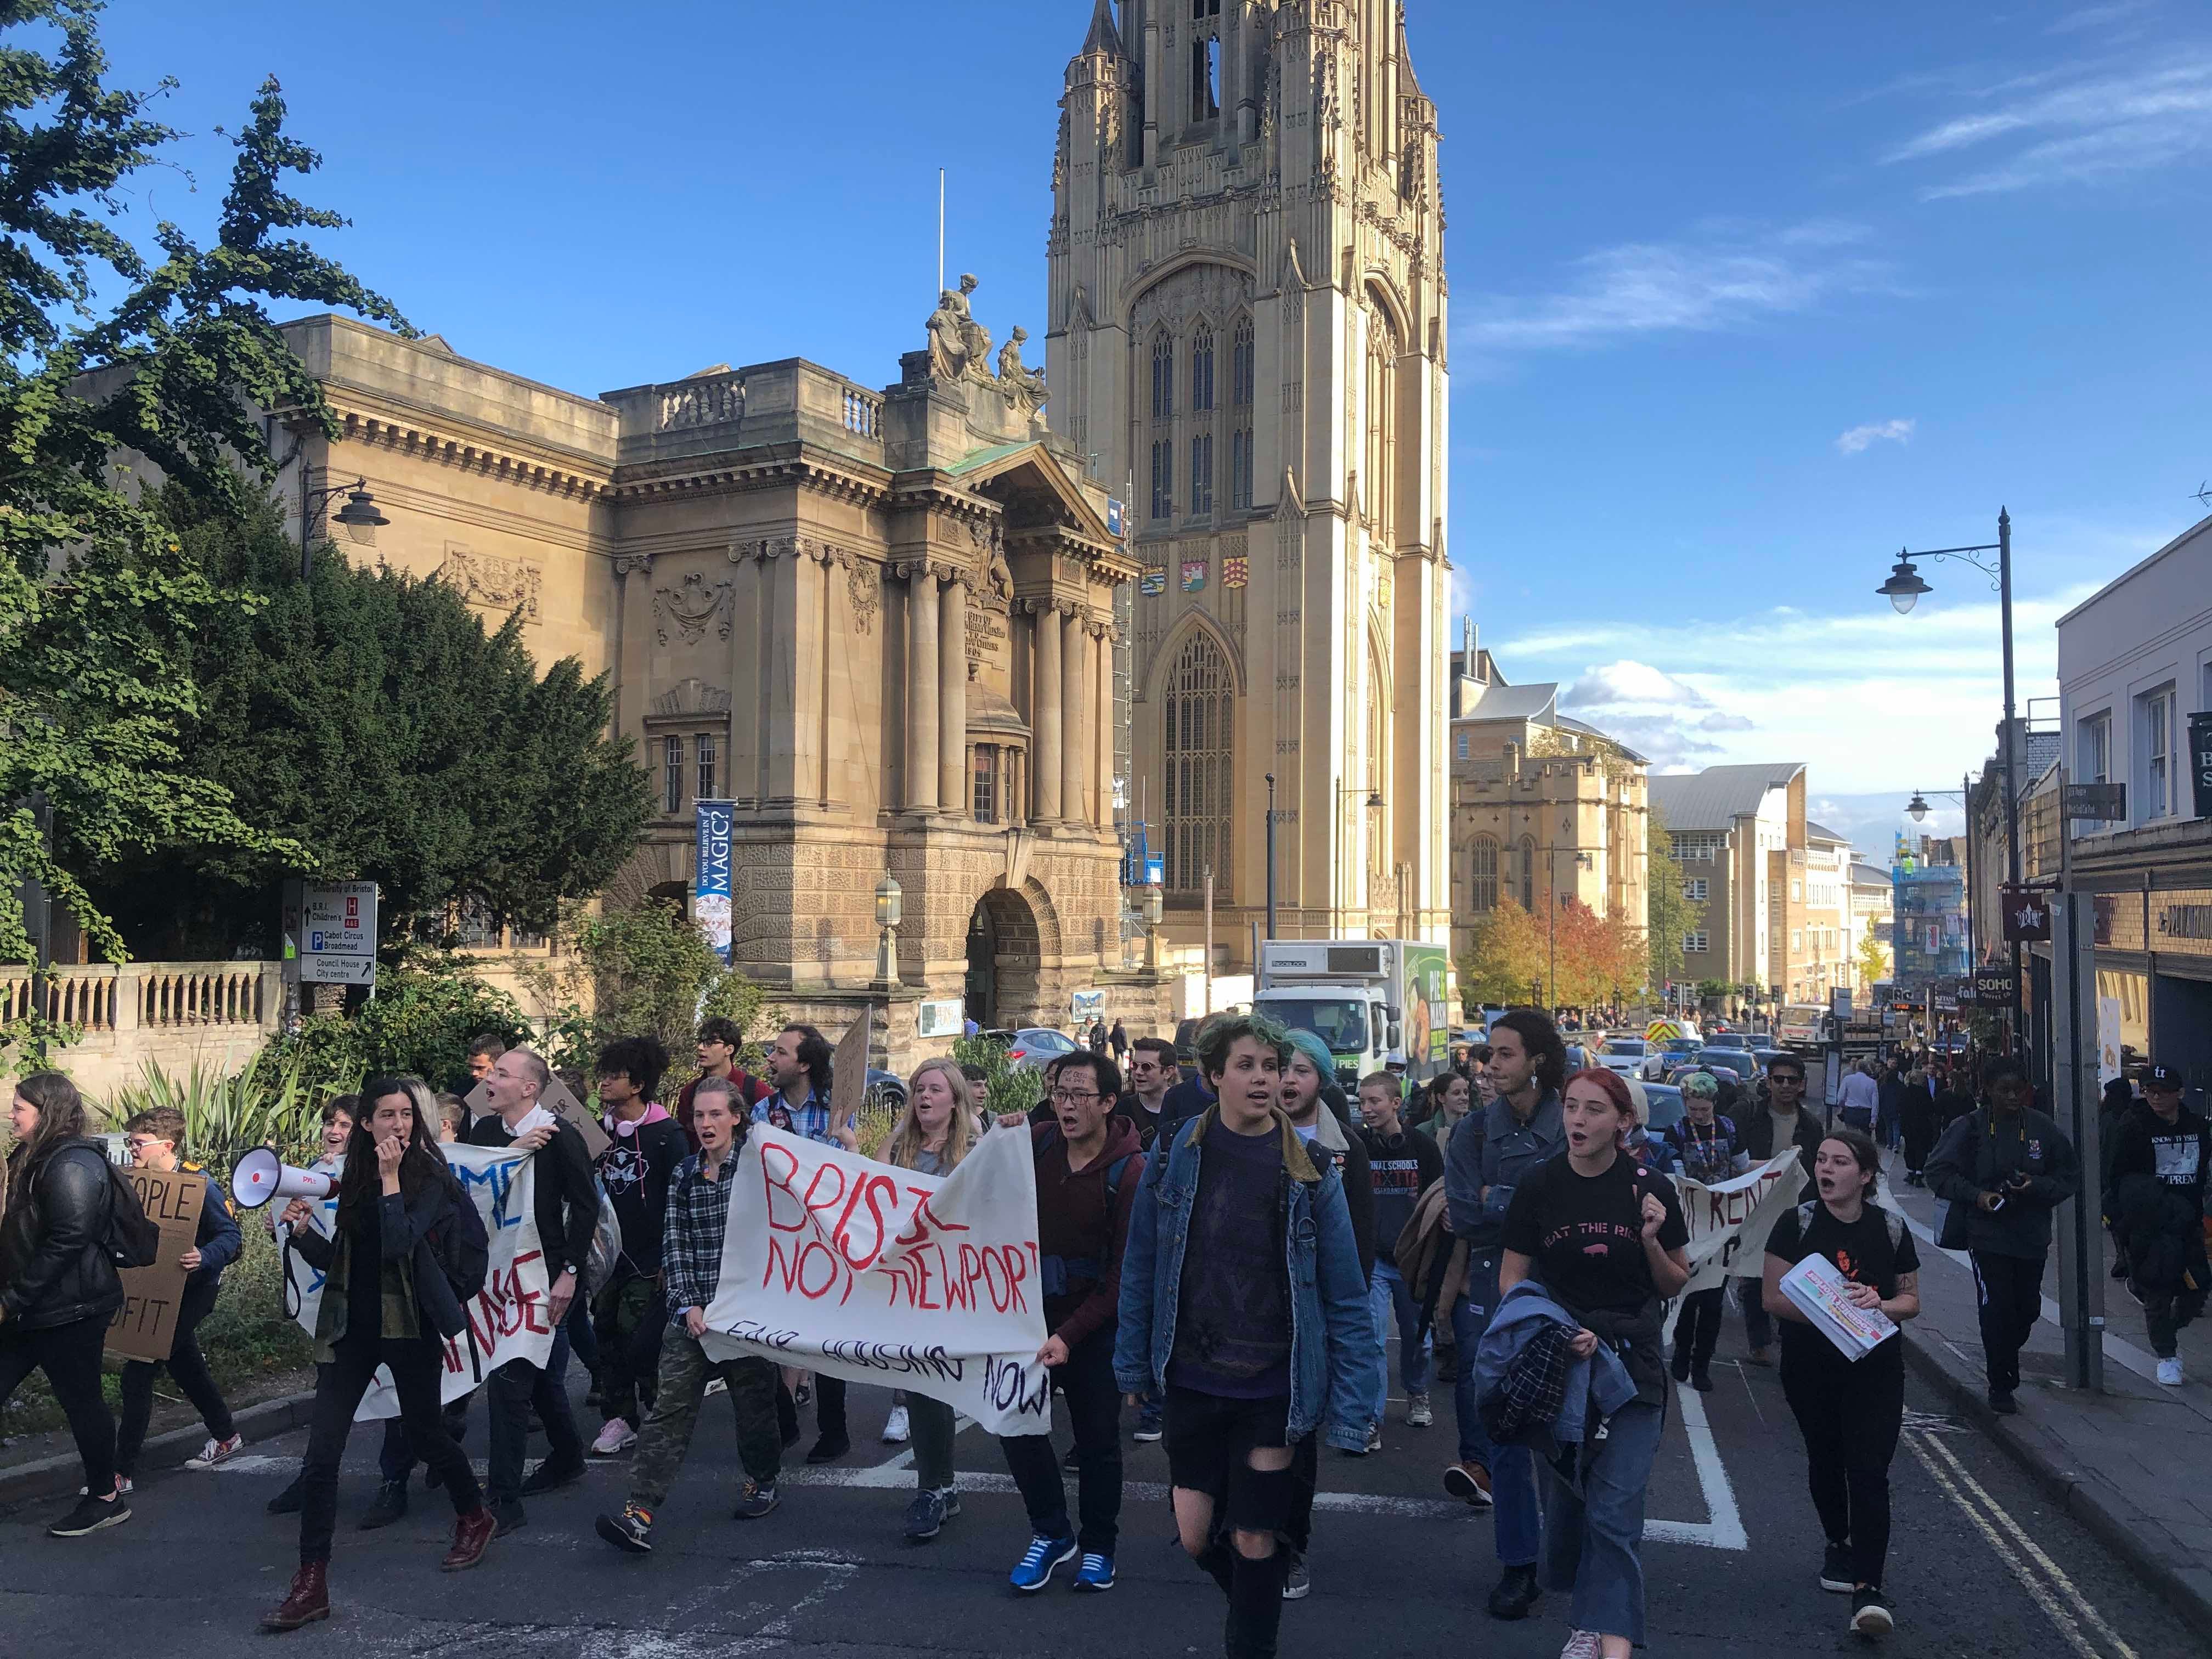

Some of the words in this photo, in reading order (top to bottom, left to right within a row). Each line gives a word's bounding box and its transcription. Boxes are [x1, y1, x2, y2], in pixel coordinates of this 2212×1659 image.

[711, 811, 730, 891] MAGIC?
[702, 876, 708, 886] DO
[313, 885, 342, 894] University
[353, 884, 373, 893] Bristol
[348, 899, 356, 914] H
[313, 913, 341, 921] Children's
[324, 931, 342, 939] Cabot
[344, 932, 363, 940] Circus
[324, 942, 358, 950] Broadmead
[317, 959, 338, 967] Council
[341, 960, 359, 968] House
[317, 969, 329, 979] City
[1430, 970, 1441, 1001] PIE
[1978, 979, 2012, 990] SOHO
[1430, 1002, 1446, 1029] MASH
[1339, 1059, 1358, 1069] PIES
[2176, 1133, 2199, 1142] TYSELF
[1388, 1160, 1418, 1170] SCHOOLS
[2155, 1174, 2196, 1185] UPREM
[126, 1174, 197, 1222] OPLE
[1710, 1170, 1782, 1232] RENT
[760, 1142, 970, 1271] BRISTL
[1544, 1225, 1571, 1248] EAT
[1577, 1222, 1608, 1234] THE
[726, 1320, 799, 1348] FAIR
[822, 1339, 965, 1382] HOUSING
[983, 1354, 1048, 1417] NOW
